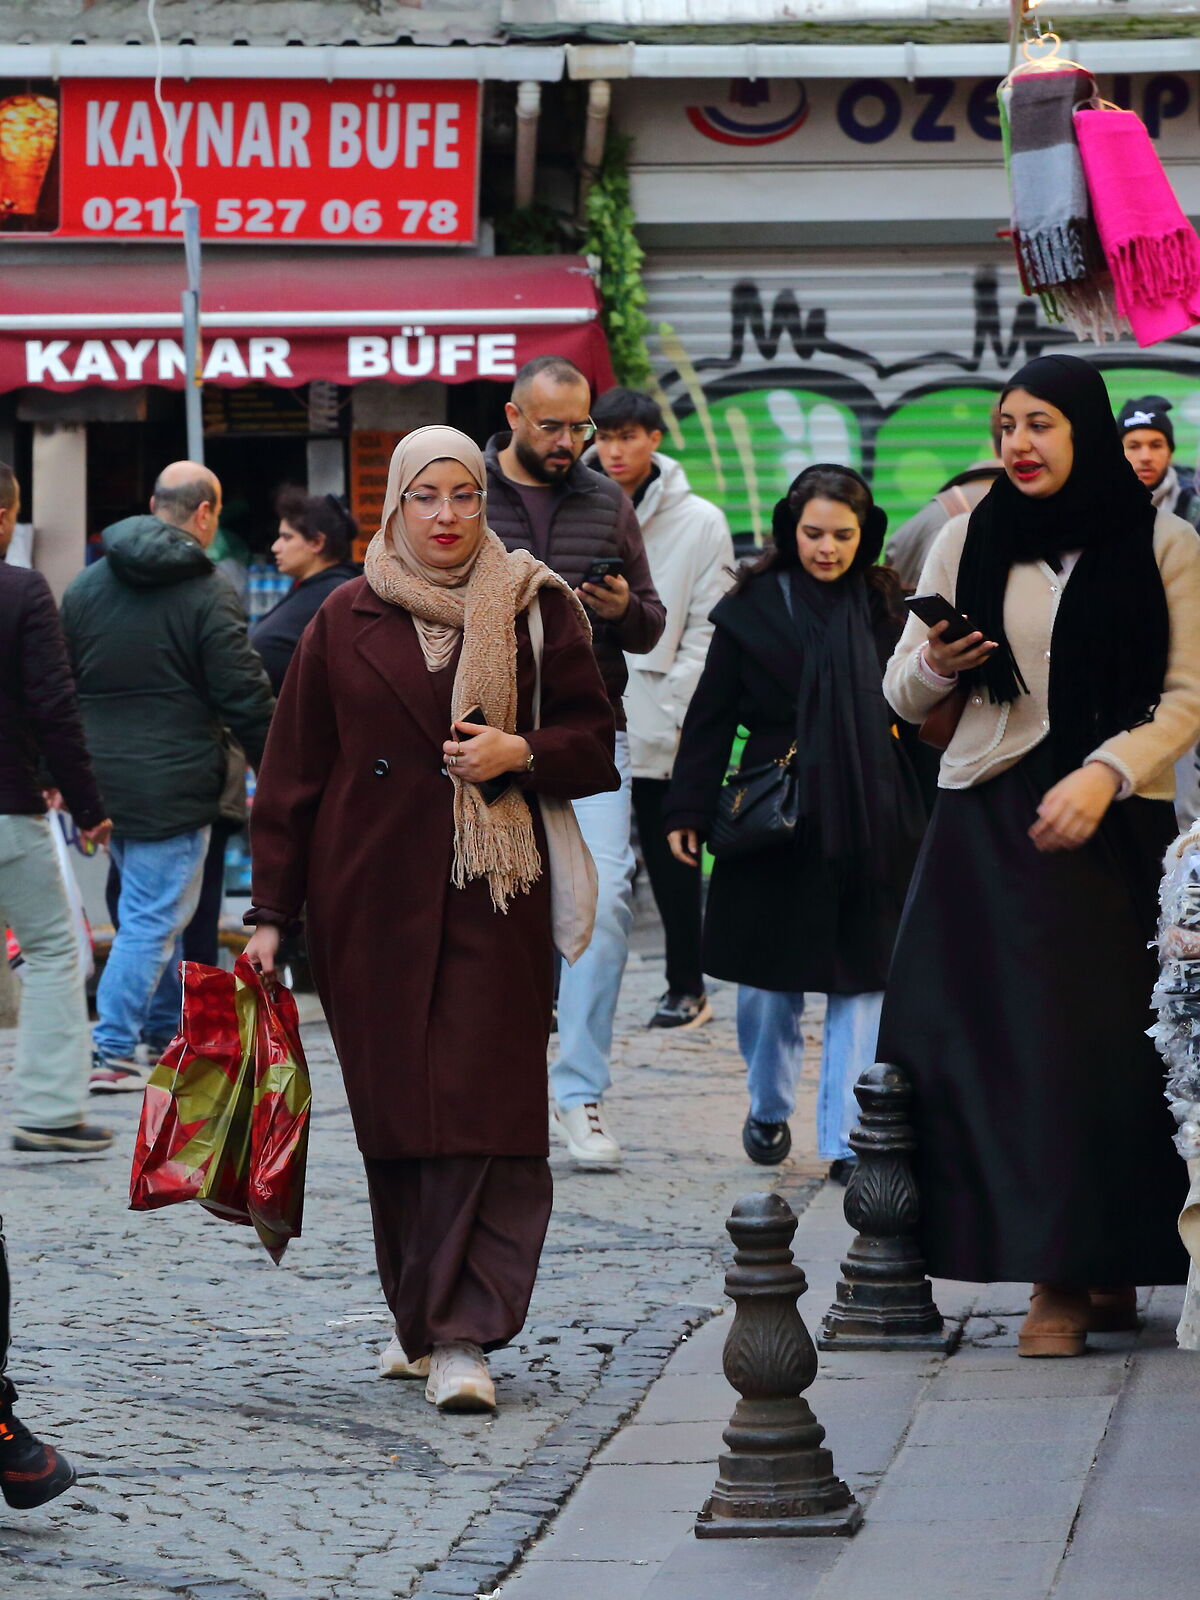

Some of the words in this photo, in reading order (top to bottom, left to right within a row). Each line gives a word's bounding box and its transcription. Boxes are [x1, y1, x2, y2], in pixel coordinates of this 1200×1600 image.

[85, 100, 311, 168] KAYNAR
[328, 83, 460, 169] BÜFE
[82, 197, 198, 231] 0212
[215, 199, 305, 233] 527
[320, 200, 382, 233] 06
[398, 199, 458, 233] 78
[25, 337, 293, 383] KAYNAR
[347, 326, 517, 378] BÜFE
